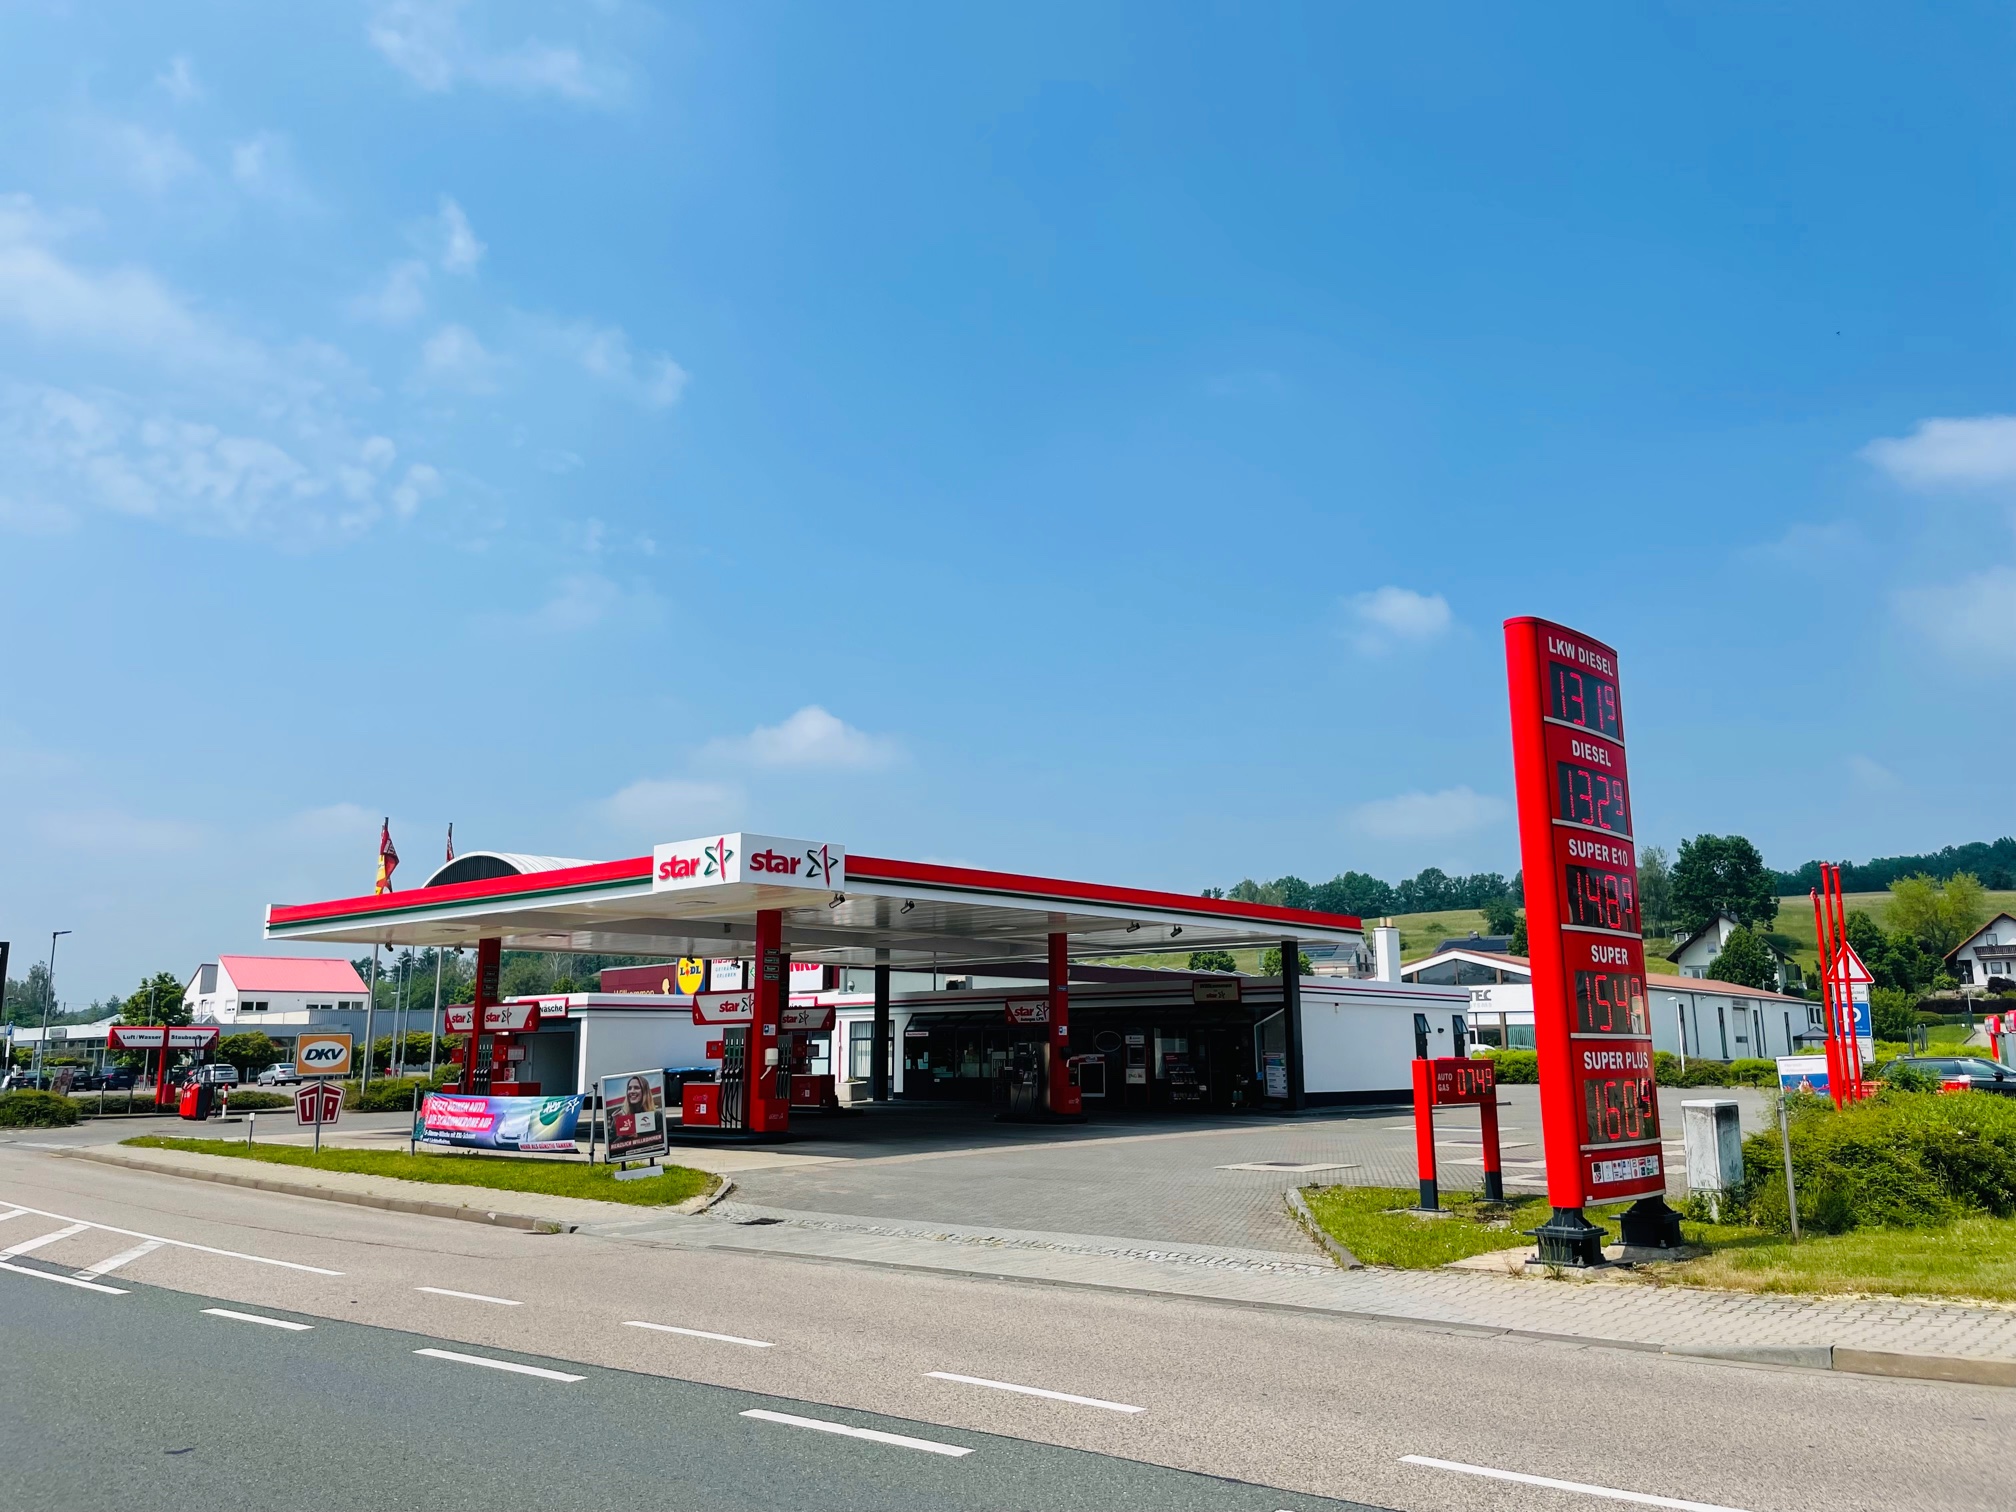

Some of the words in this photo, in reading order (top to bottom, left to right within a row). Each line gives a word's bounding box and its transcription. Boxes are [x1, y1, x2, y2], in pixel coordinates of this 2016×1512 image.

[1548, 636, 1575, 660] LKW
[1578, 646, 1613, 677] DIESEL
[1572, 740, 1611, 767] DIESEL
[1568, 770, 1624, 829] 1329
[750, 849, 801, 874] star
[1569, 839, 1609, 862] SUPER
[1612, 847, 1628, 867] E10
[658, 855, 700, 881] star
[1591, 945, 1628, 965] SUPER
[719, 1000, 739, 1013] star
[1014, 1006, 1034, 1016] star
[1586, 975, 1642, 1031] 1549
[452, 1012, 466, 1024] star
[486, 1012, 500, 1022] star
[782, 1014, 798, 1024] star
[304, 1048, 344, 1060] DKV
[1584, 1052, 1624, 1070] SUPER
[1626, 1052, 1648, 1069] PLUS
[1457, 1068, 1492, 1095] 0749
[468, 1102, 486, 1112] AUTO
[1595, 1081, 1652, 1140] 1609
[478, 1118, 492, 1128] AUF
